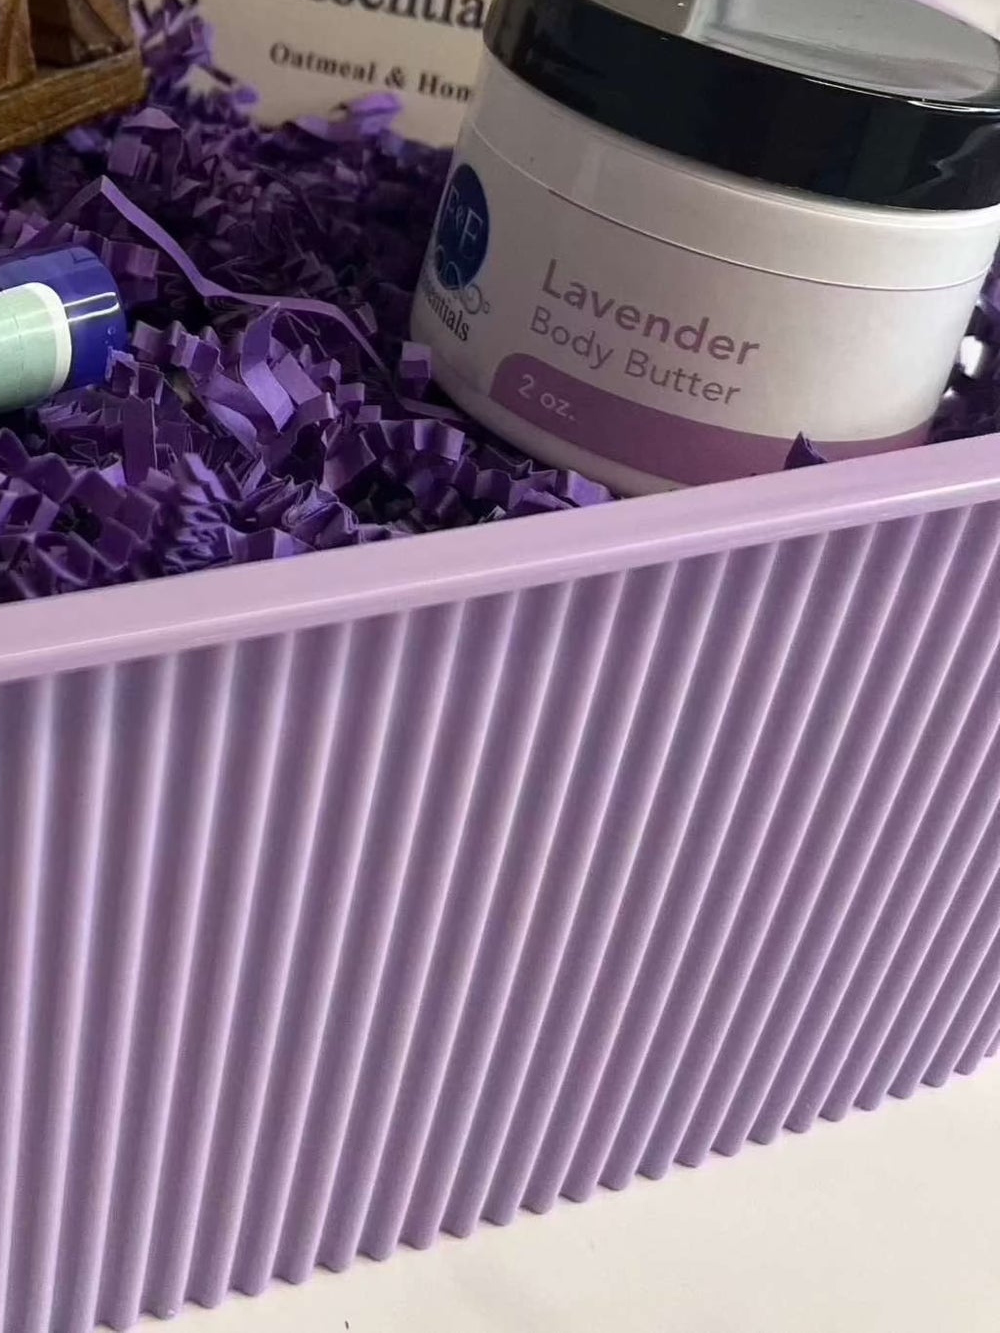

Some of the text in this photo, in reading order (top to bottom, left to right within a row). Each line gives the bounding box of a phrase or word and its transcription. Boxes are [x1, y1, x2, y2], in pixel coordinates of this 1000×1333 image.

[269, 42, 472, 103] Oatmeal & Hon
[542, 259, 760, 365] Lavender
[530, 305, 741, 405] Body Butter
[517, 374, 577, 422] 2 oz.
